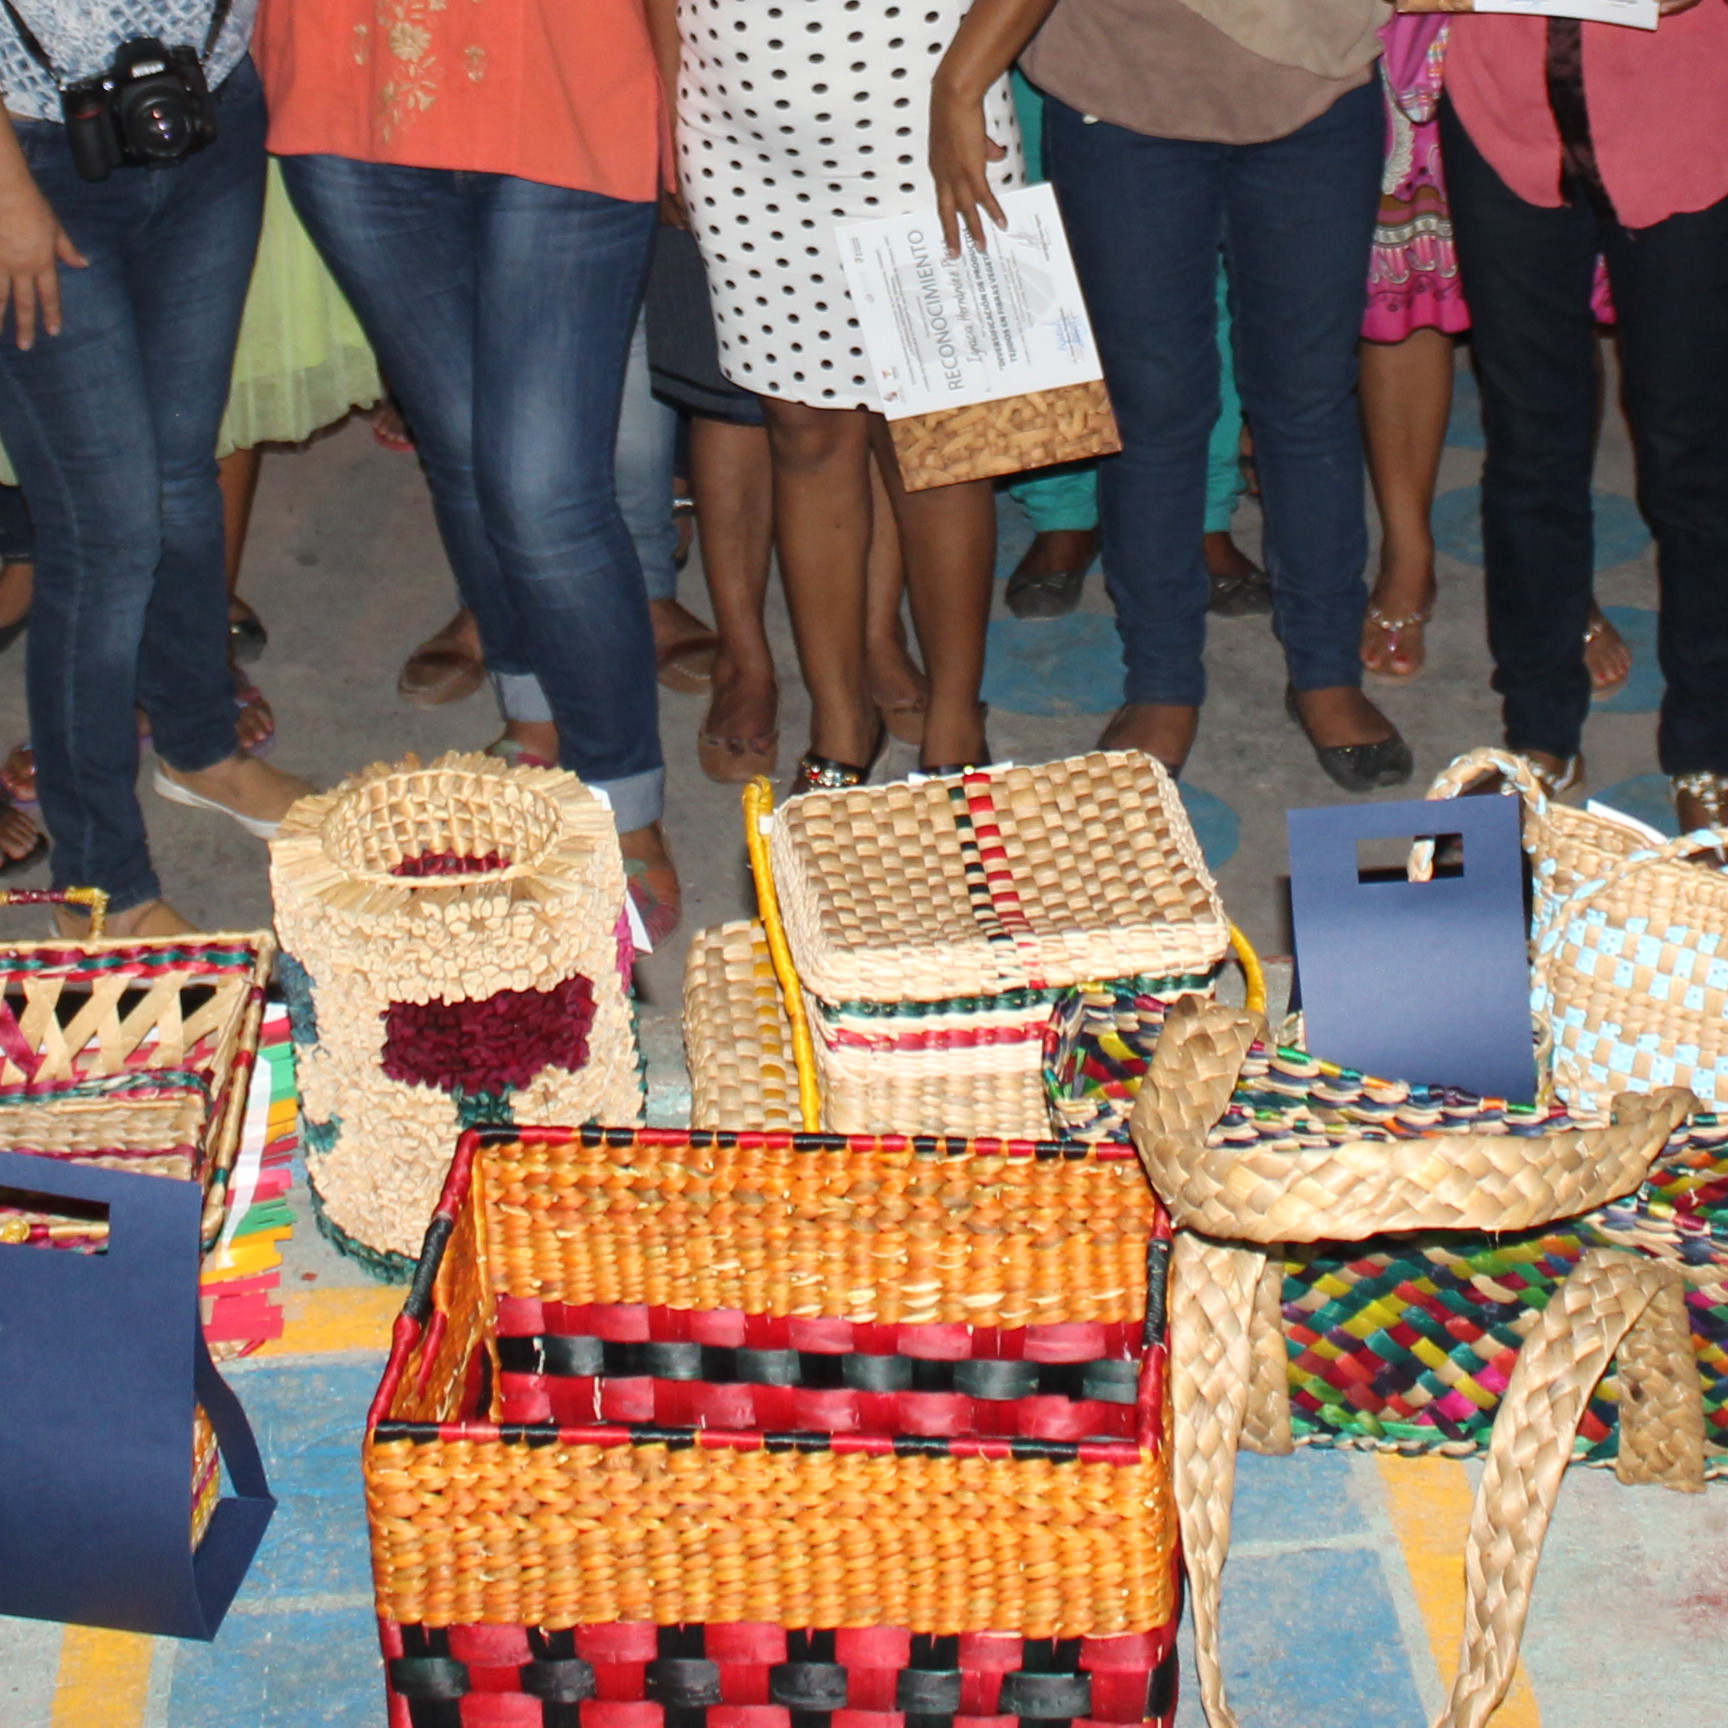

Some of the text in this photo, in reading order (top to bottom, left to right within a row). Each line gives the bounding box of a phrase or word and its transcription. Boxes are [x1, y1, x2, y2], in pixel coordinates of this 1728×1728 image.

[977, 283, 985, 293] DE
[991, 284, 1004, 314] FIBRAS
[907, 230, 964, 391] RECONOCIMIENTO
[998, 315, 1007, 325] EN
[966, 325, 987, 364] Ignacia
[1002, 326, 1017, 362] TEJIDOS
